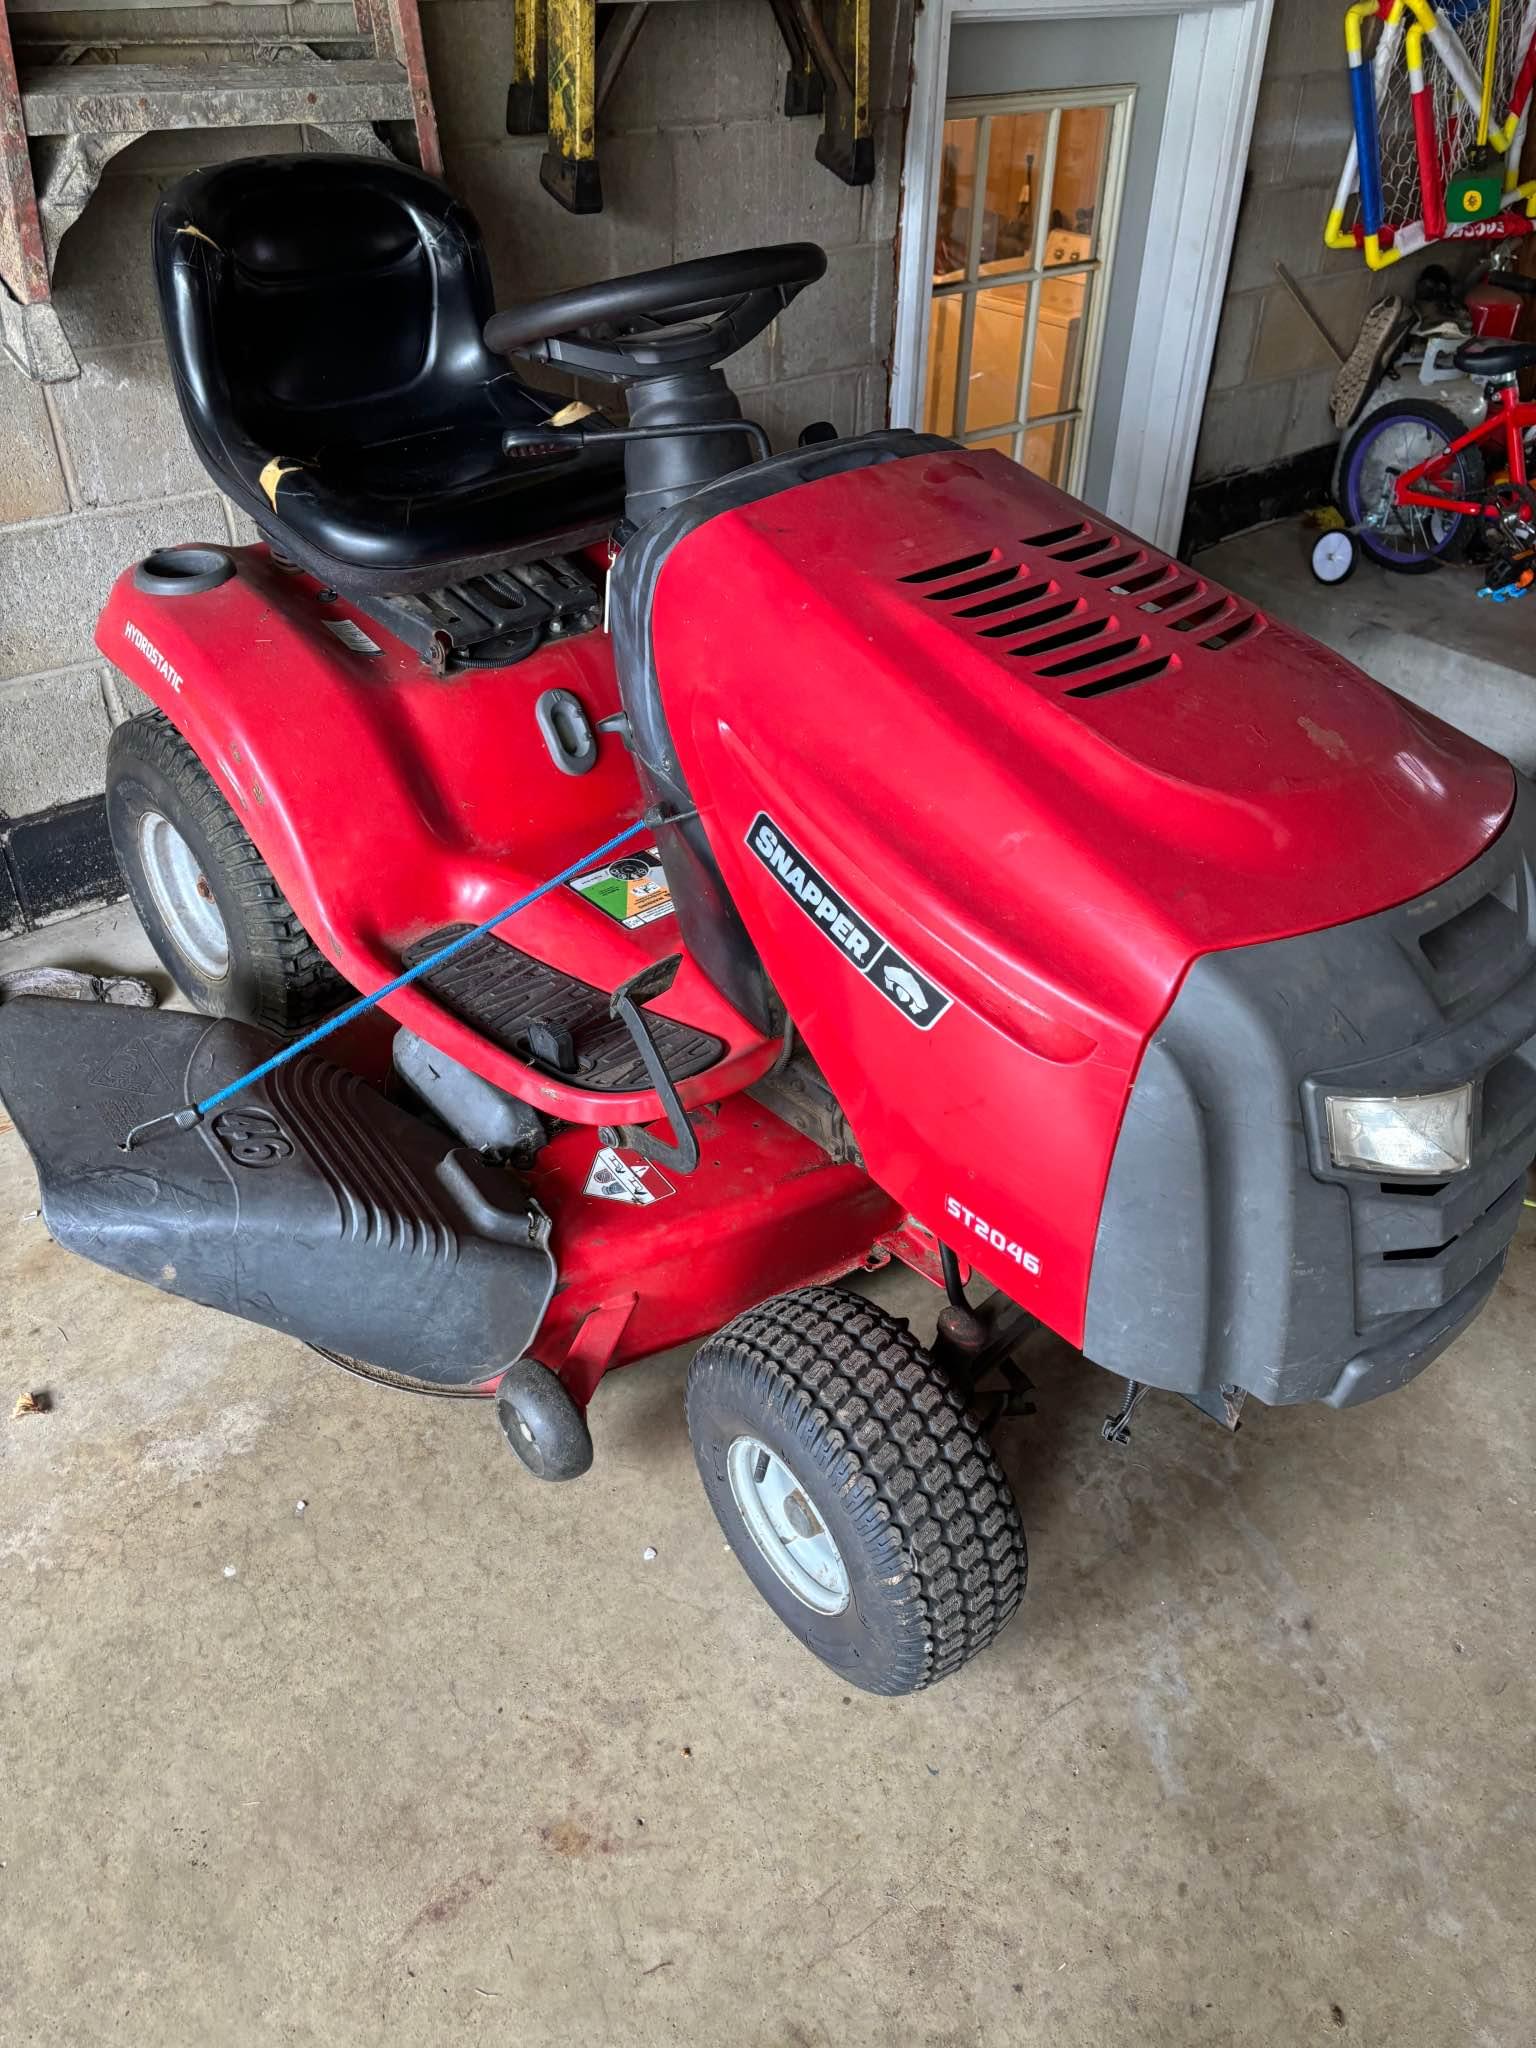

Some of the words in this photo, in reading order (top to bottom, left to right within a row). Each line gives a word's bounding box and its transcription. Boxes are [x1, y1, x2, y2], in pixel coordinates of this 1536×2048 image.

[124, 620, 184, 694] HYDROSTATIC
[755, 825, 870, 961] SNAPPER
[215, 1112, 291, 1164] 46
[946, 1196, 1041, 1275] ST2046
